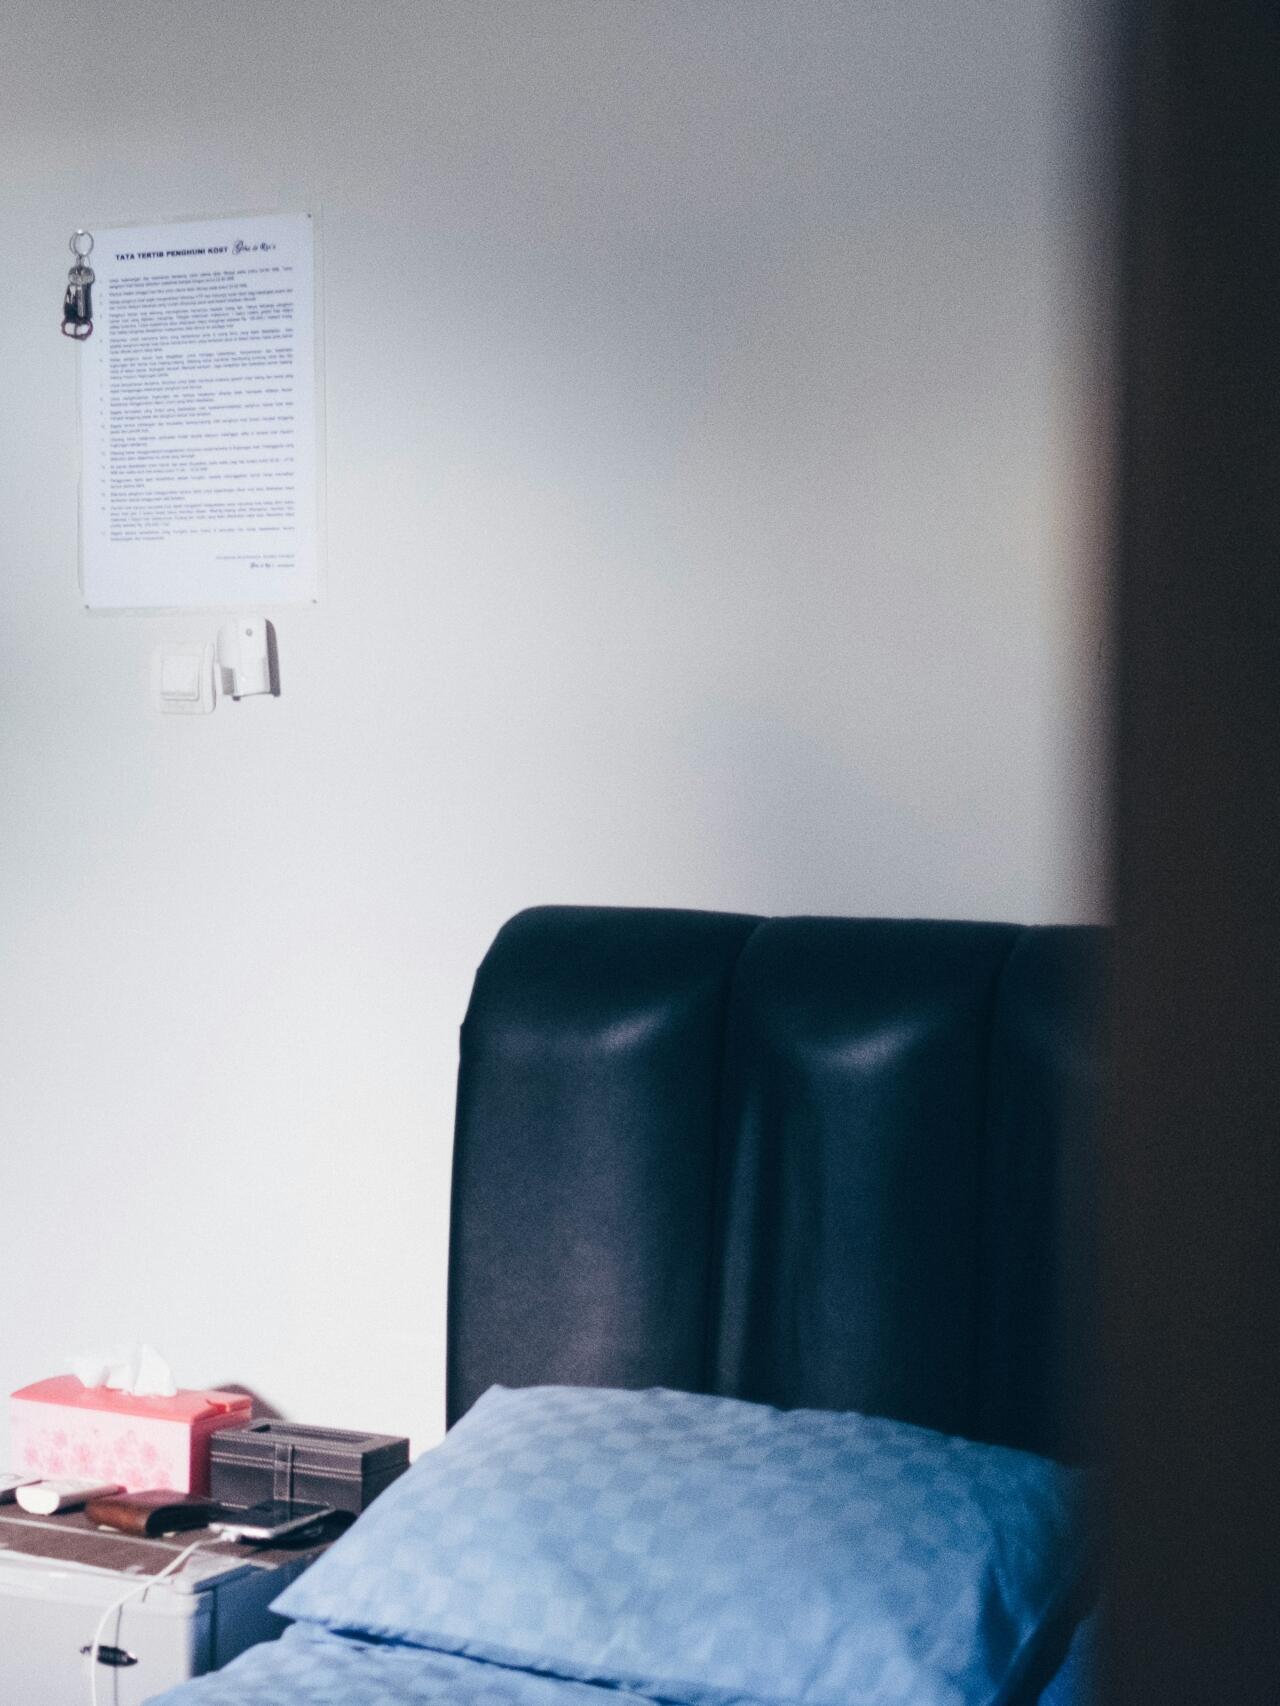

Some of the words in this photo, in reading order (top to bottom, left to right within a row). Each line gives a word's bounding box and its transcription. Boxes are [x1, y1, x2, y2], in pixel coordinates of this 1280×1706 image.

[115, 253, 135, 261] TATA
[137, 251, 164, 259] TERTIB
[166, 248, 206, 257] PENGHUNI
[207, 246, 228, 254] KOST
